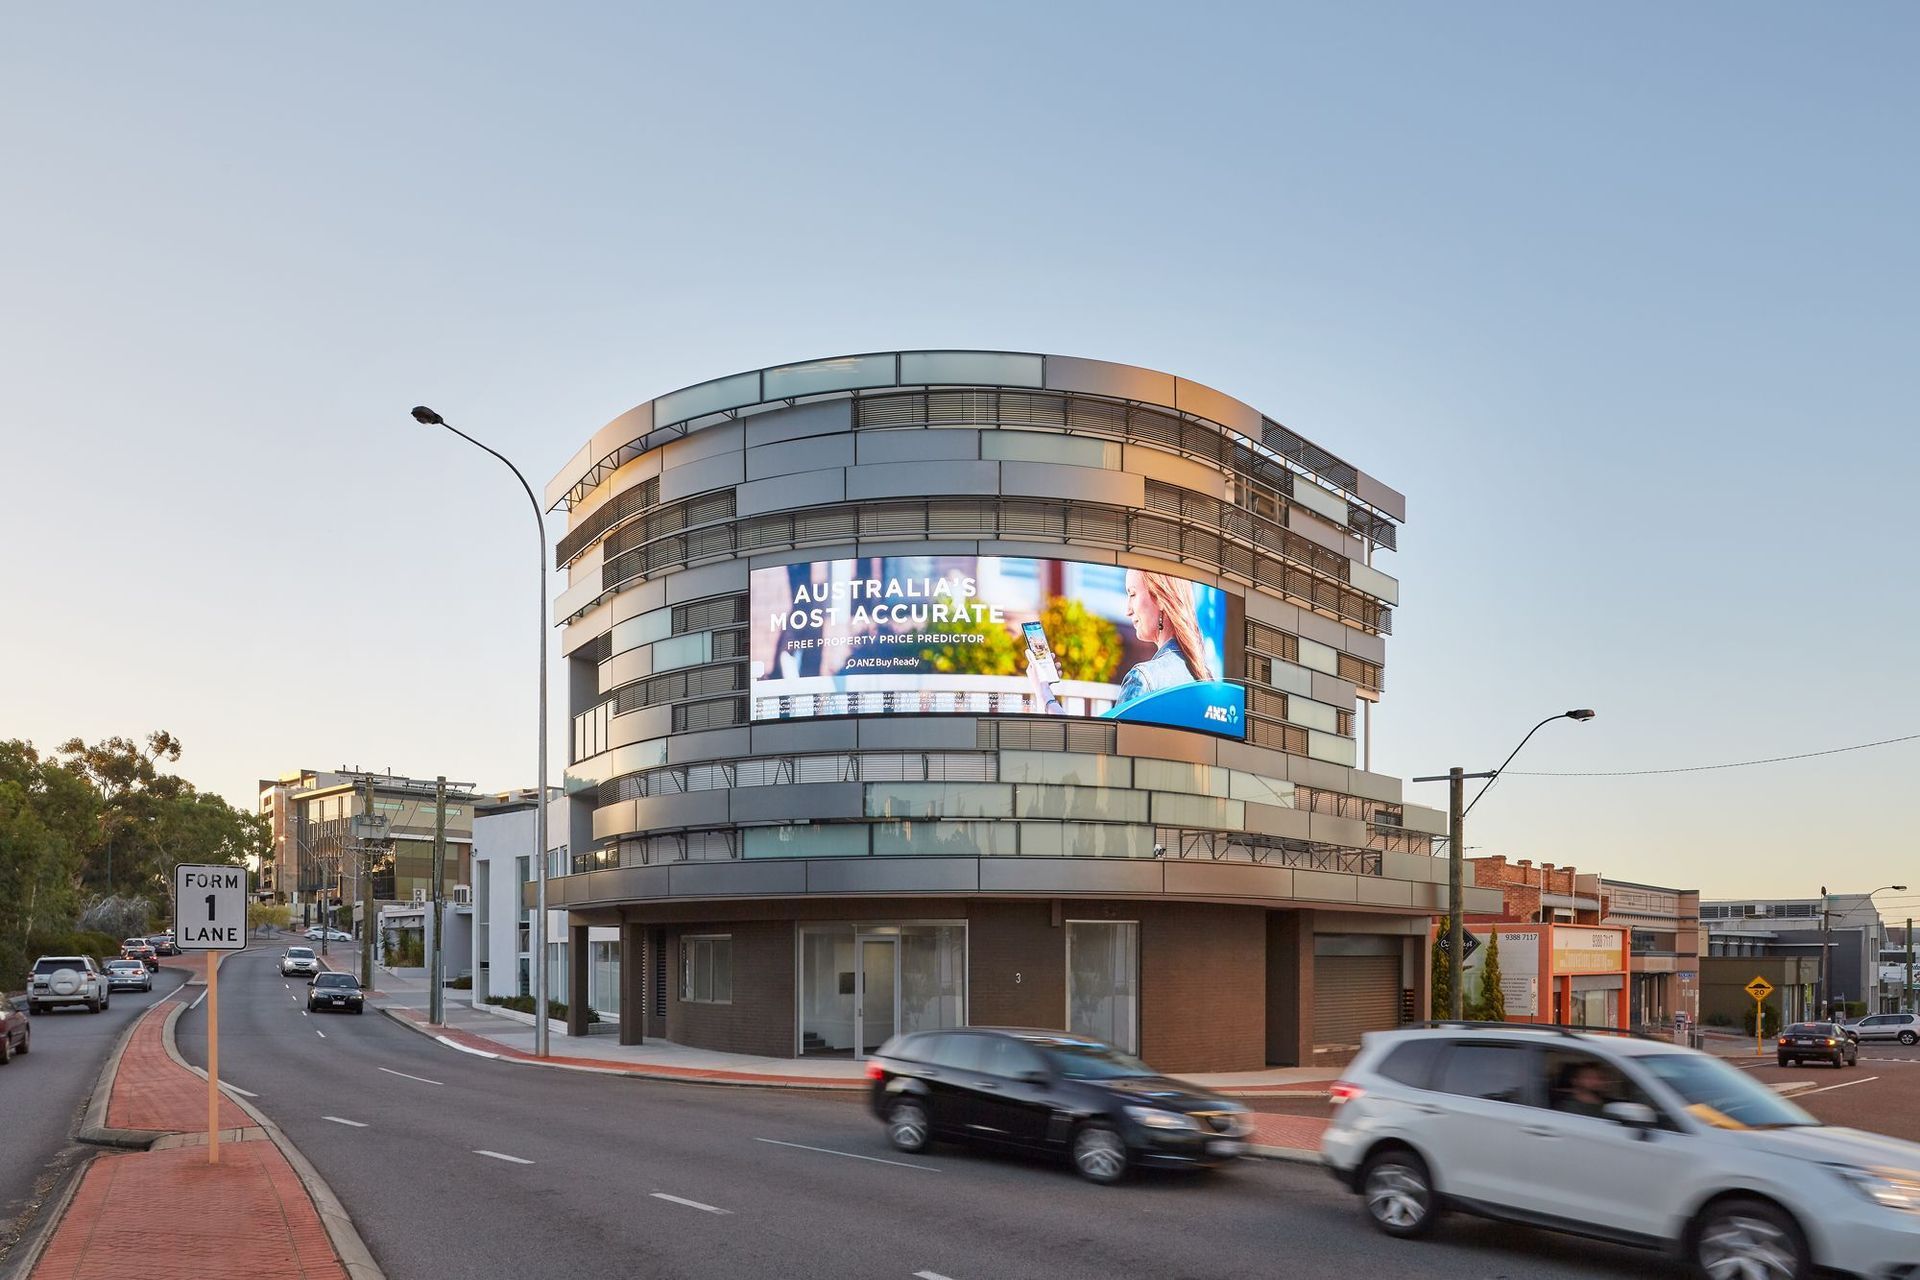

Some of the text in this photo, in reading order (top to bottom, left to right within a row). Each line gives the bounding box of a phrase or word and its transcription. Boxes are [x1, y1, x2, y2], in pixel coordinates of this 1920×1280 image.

[794, 578, 977, 604] AUSTRALIA'S
[770, 603, 1006, 632] MOST ACCURATE
[787, 633, 985, 650] FREE PROPERTY PRICE PREDICTOR
[856, 657, 920, 668] ANZ Buy Ready
[1204, 704, 1228, 722] ANZ
[185, 873, 238, 889] FORM
[205, 894, 216, 921] 1
[184, 927, 238, 942] LANE
[1505, 933, 1537, 941] 9388 7117
[1015, 972, 1022, 984] 3
